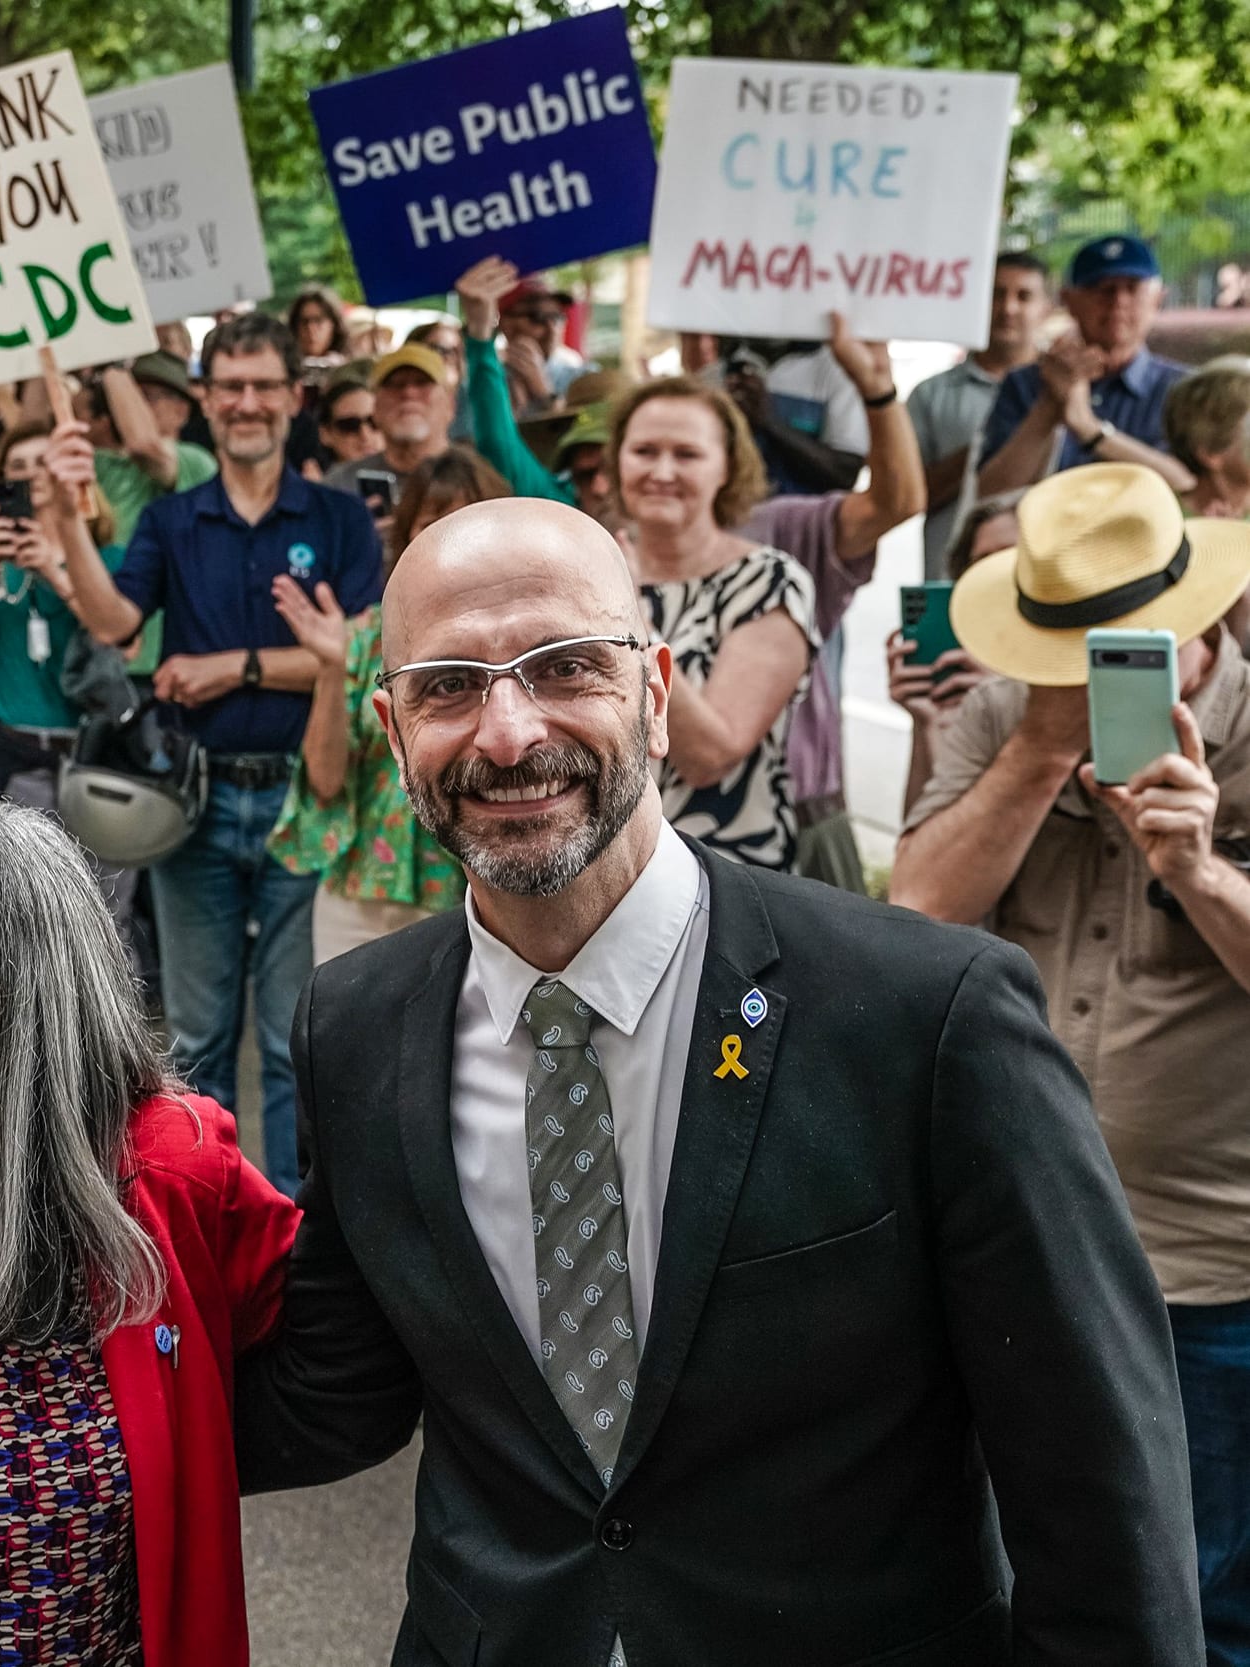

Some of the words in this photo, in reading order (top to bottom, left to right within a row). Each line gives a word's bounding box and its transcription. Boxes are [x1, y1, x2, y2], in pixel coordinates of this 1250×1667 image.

[332, 126, 455, 187] Save
[458, 68, 634, 155] Public
[737, 77, 951, 119] NEEDED:
[721, 132, 908, 199] CURE
[405, 160, 593, 249] Health
[680, 239, 972, 300] MAGA-VIRUS
